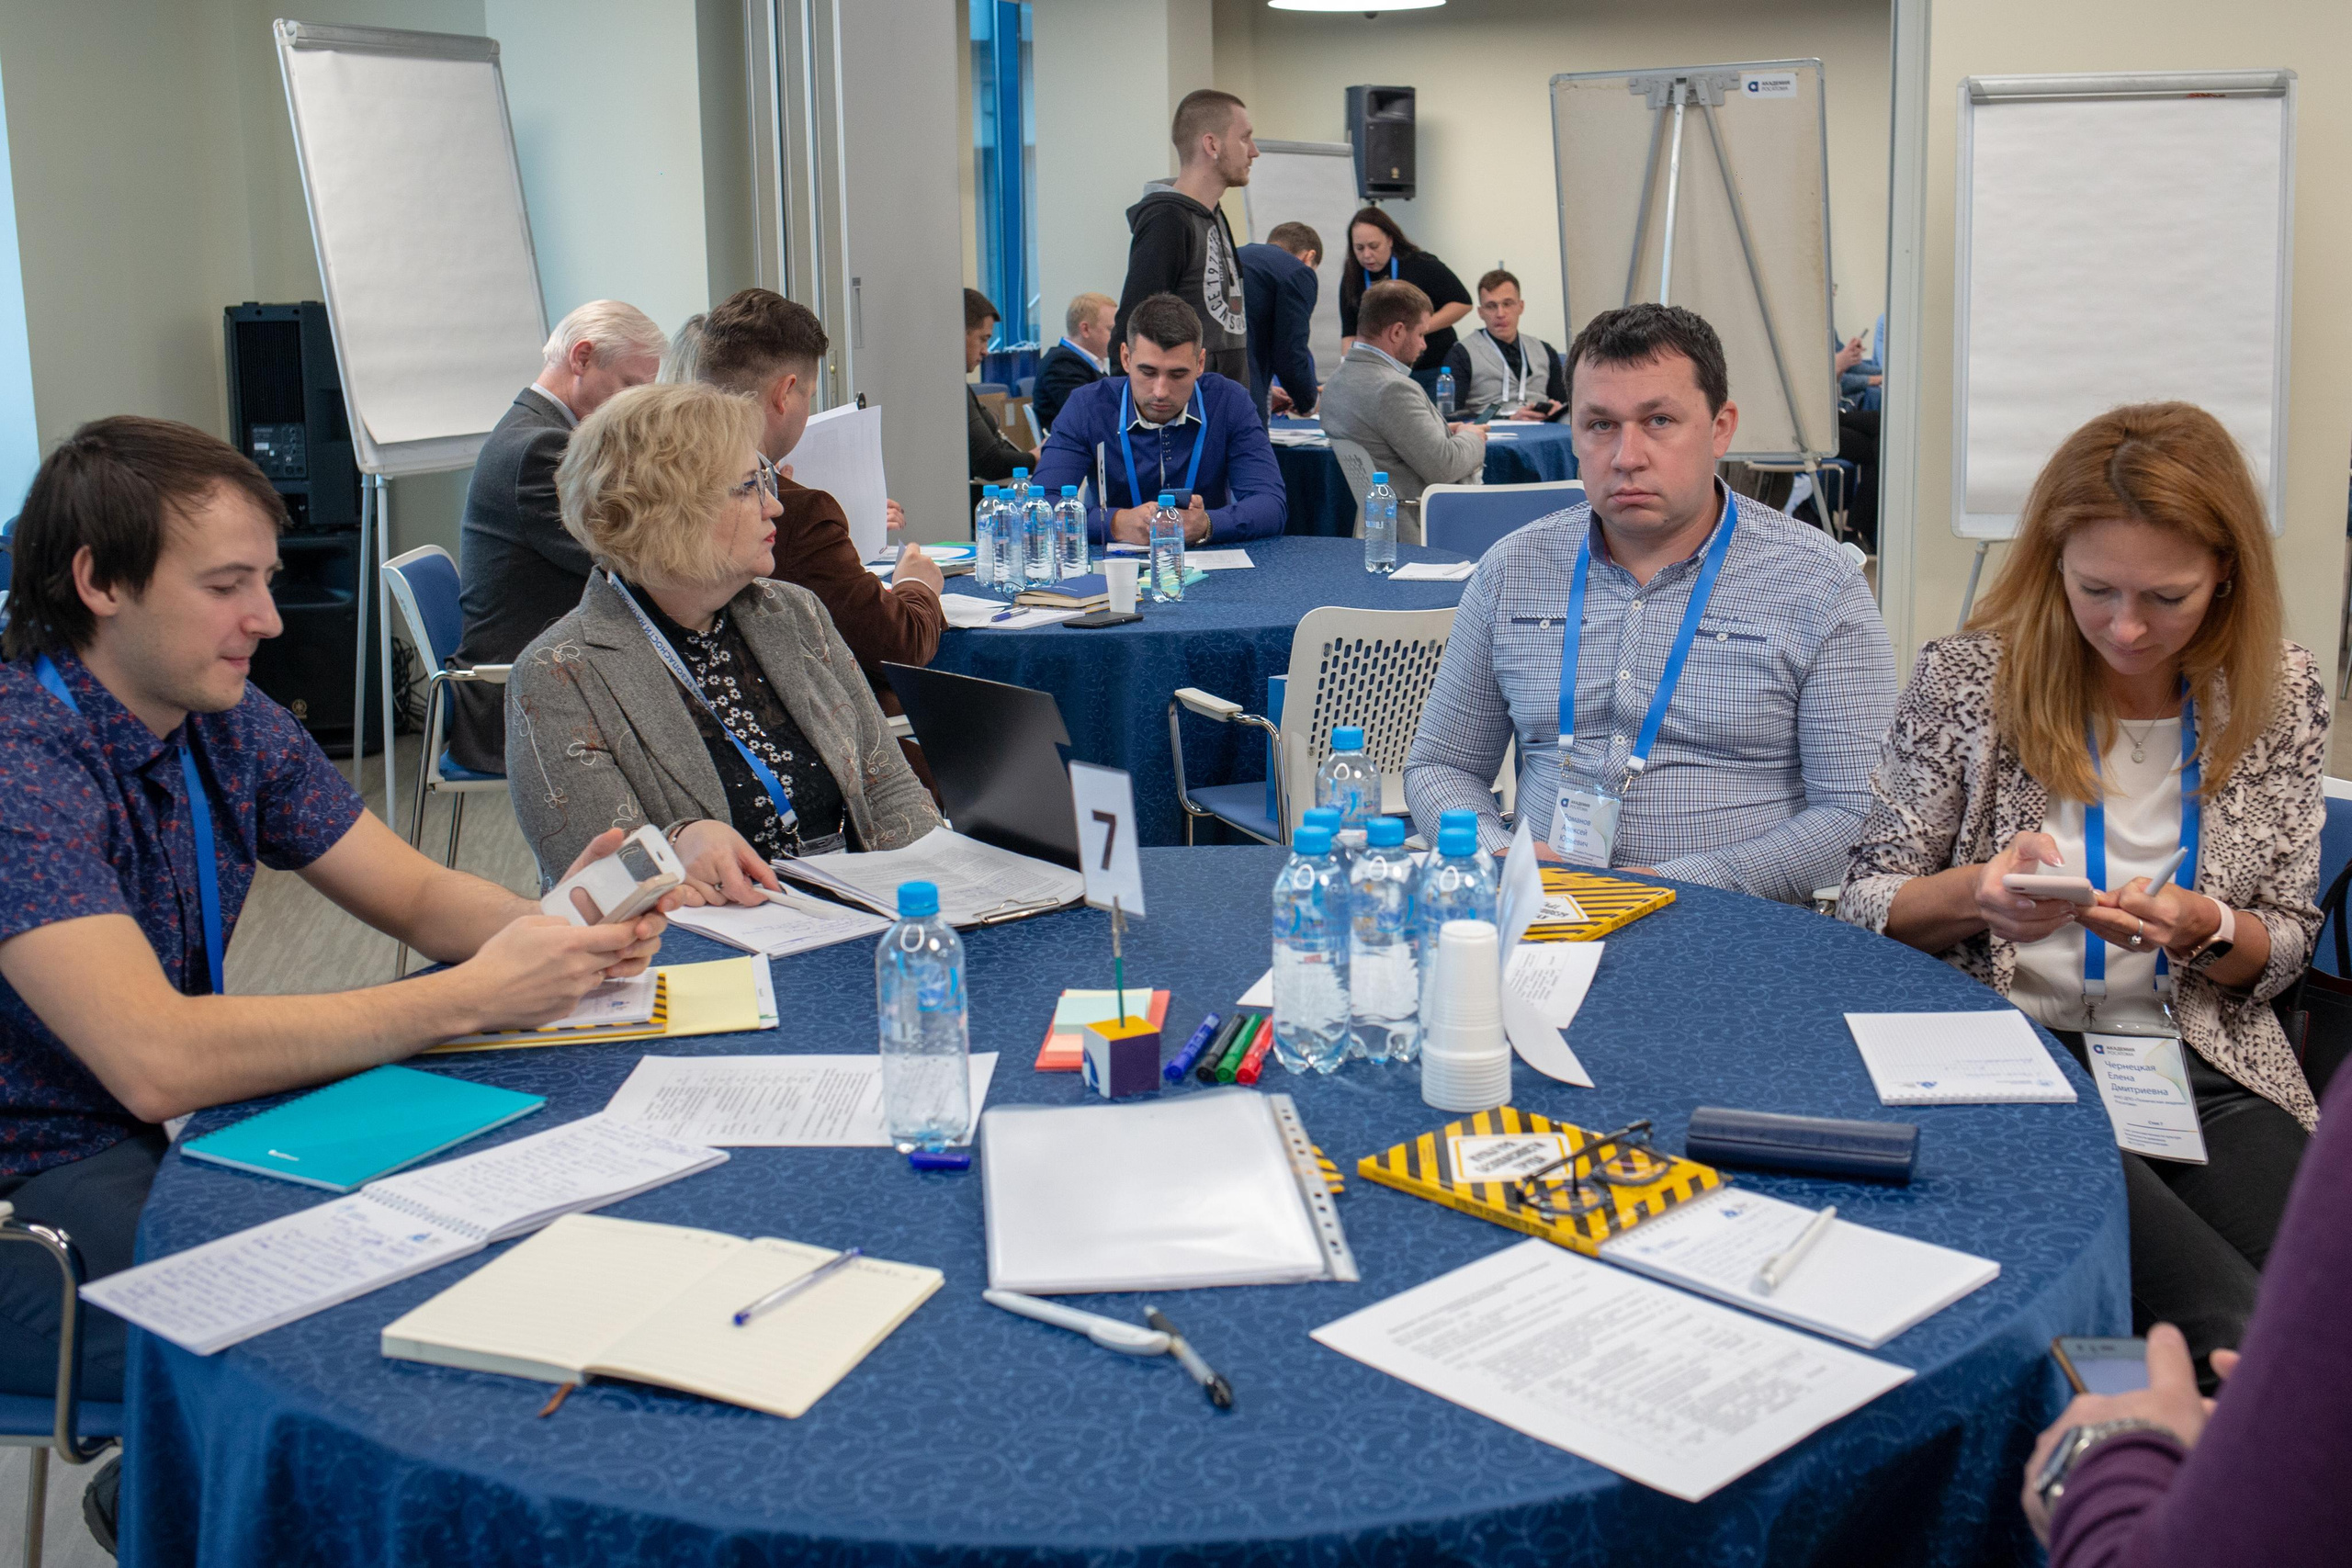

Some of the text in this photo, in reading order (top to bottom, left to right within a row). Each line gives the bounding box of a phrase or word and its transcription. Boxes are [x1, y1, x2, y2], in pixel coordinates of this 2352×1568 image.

[1565, 813, 1591, 826] Романов
[1091, 809, 1116, 871] 7
[2104, 1060, 2156, 1072] Чернецкая
[2107, 1071, 2135, 1082] Елена
[2110, 1082, 2169, 1096] Дмитриевна
